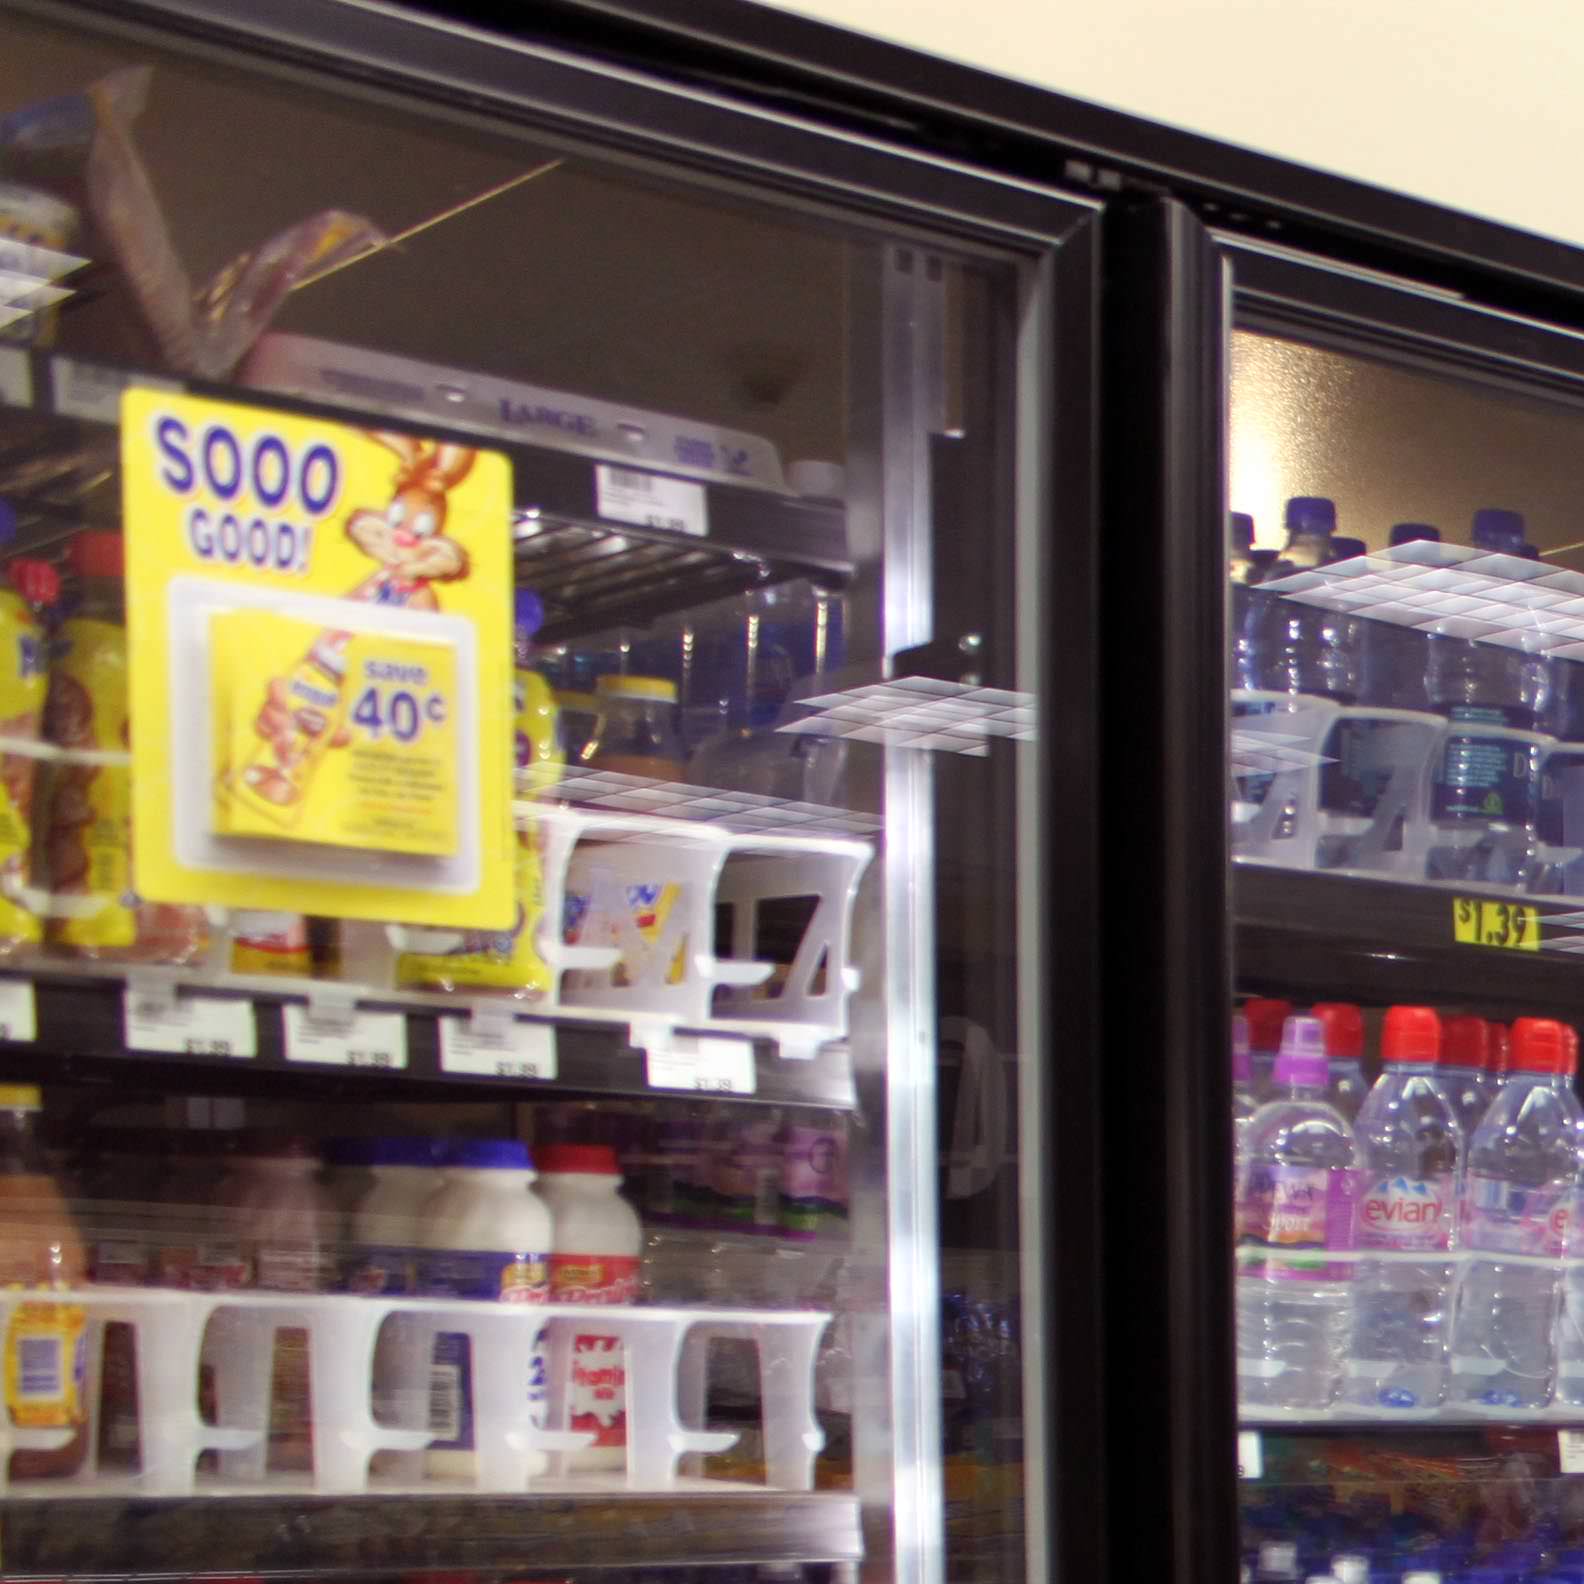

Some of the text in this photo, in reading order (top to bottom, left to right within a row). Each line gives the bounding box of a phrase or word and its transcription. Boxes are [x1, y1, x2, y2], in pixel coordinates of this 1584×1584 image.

[154, 413, 339, 518] SOOO
[189, 507, 314, 574] GOOD!
[1457, 897, 1527, 947] $1.39
[1363, 1201, 1443, 1223] evian
